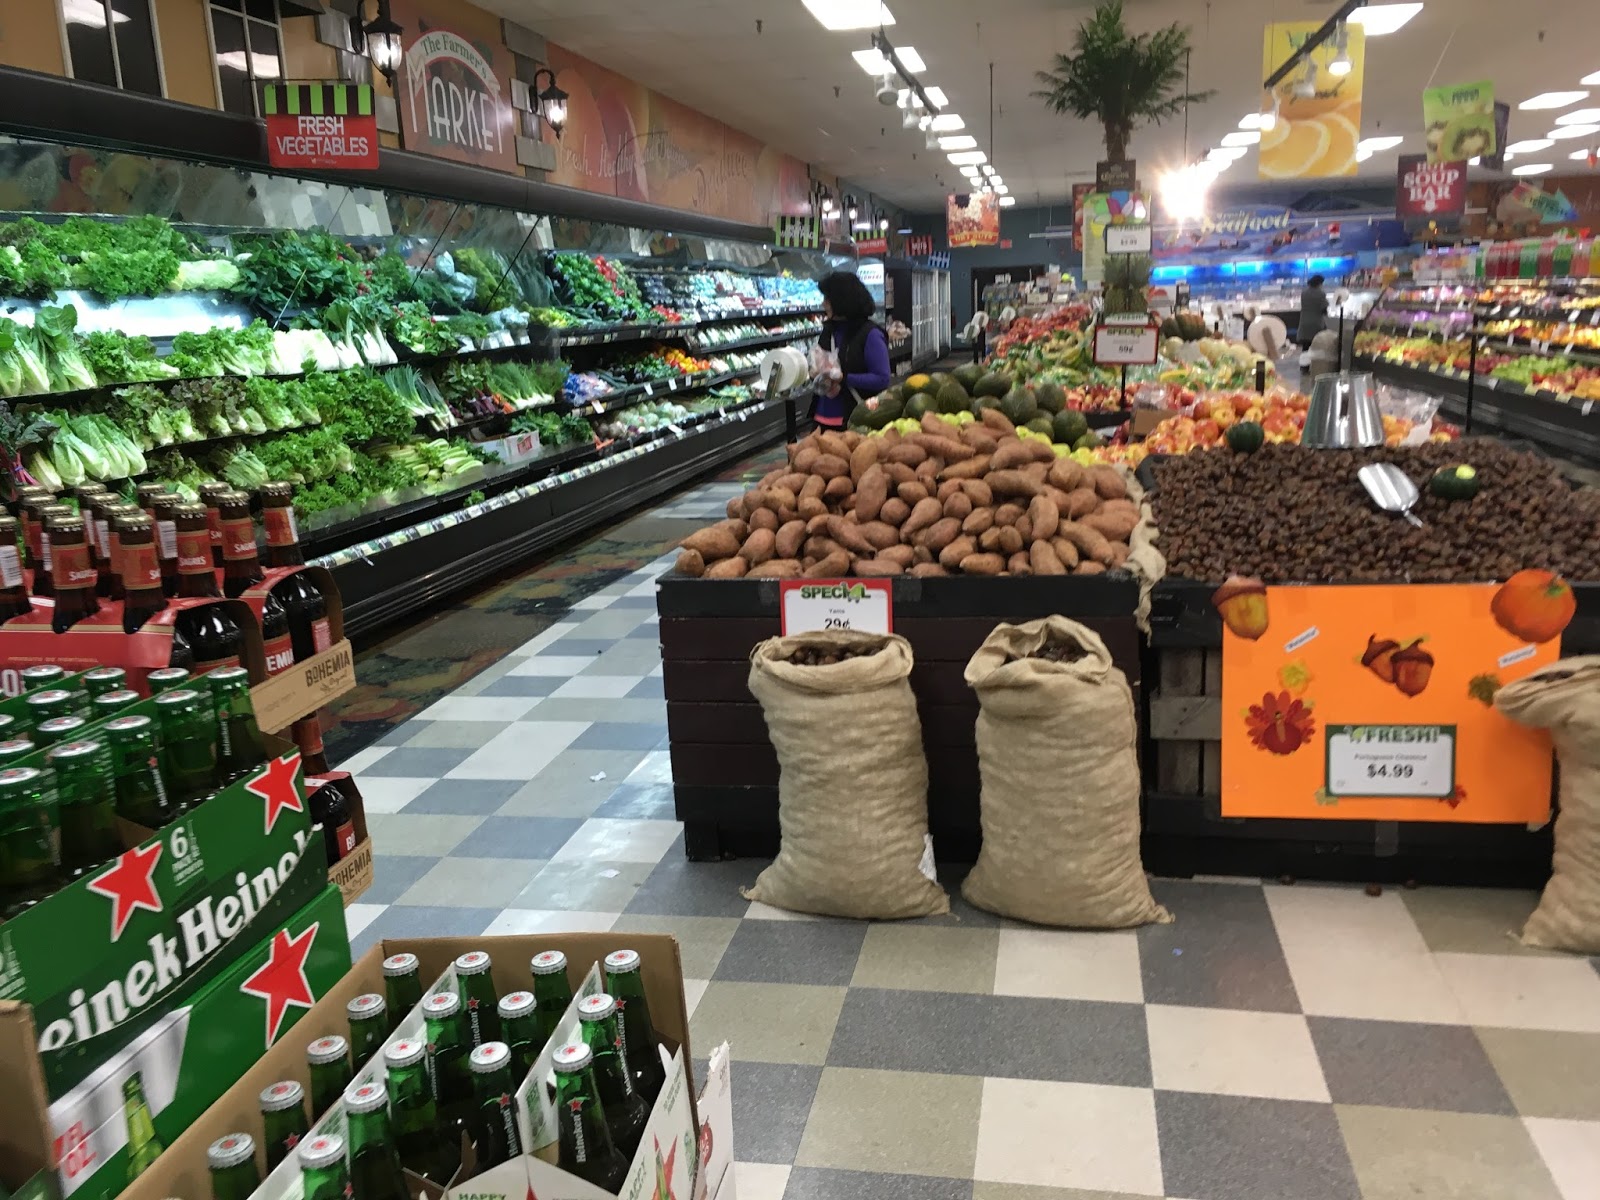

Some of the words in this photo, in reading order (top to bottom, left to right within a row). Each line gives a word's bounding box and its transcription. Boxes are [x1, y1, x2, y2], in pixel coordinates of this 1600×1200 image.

[421, 36, 441, 56] The
[441, 34, 487, 79] Farmer's
[405, 51, 504, 154] MARKET
[298, 116, 344, 136] FRESH
[276, 136, 368, 156] VEGETABLES
[1404, 169, 1459, 188] SOUP
[1409, 185, 1451, 201] BAR
[1201, 208, 1291, 236] Seafood
[801, 582, 871, 599] SPECIAL
[305, 650, 351, 688] BOHEMIA
[1364, 727, 1440, 743] FRESH!
[1367, 763, 1414, 778] $4.99
[170, 826, 189, 859] 6
[38, 932, 183, 1054] einek
[471, 1011, 482, 1048] eineken
[503, 1108, 519, 1157] Heineken
[573, 1113, 587, 1163] Heineken
[628, 1156, 647, 1200] APPY
